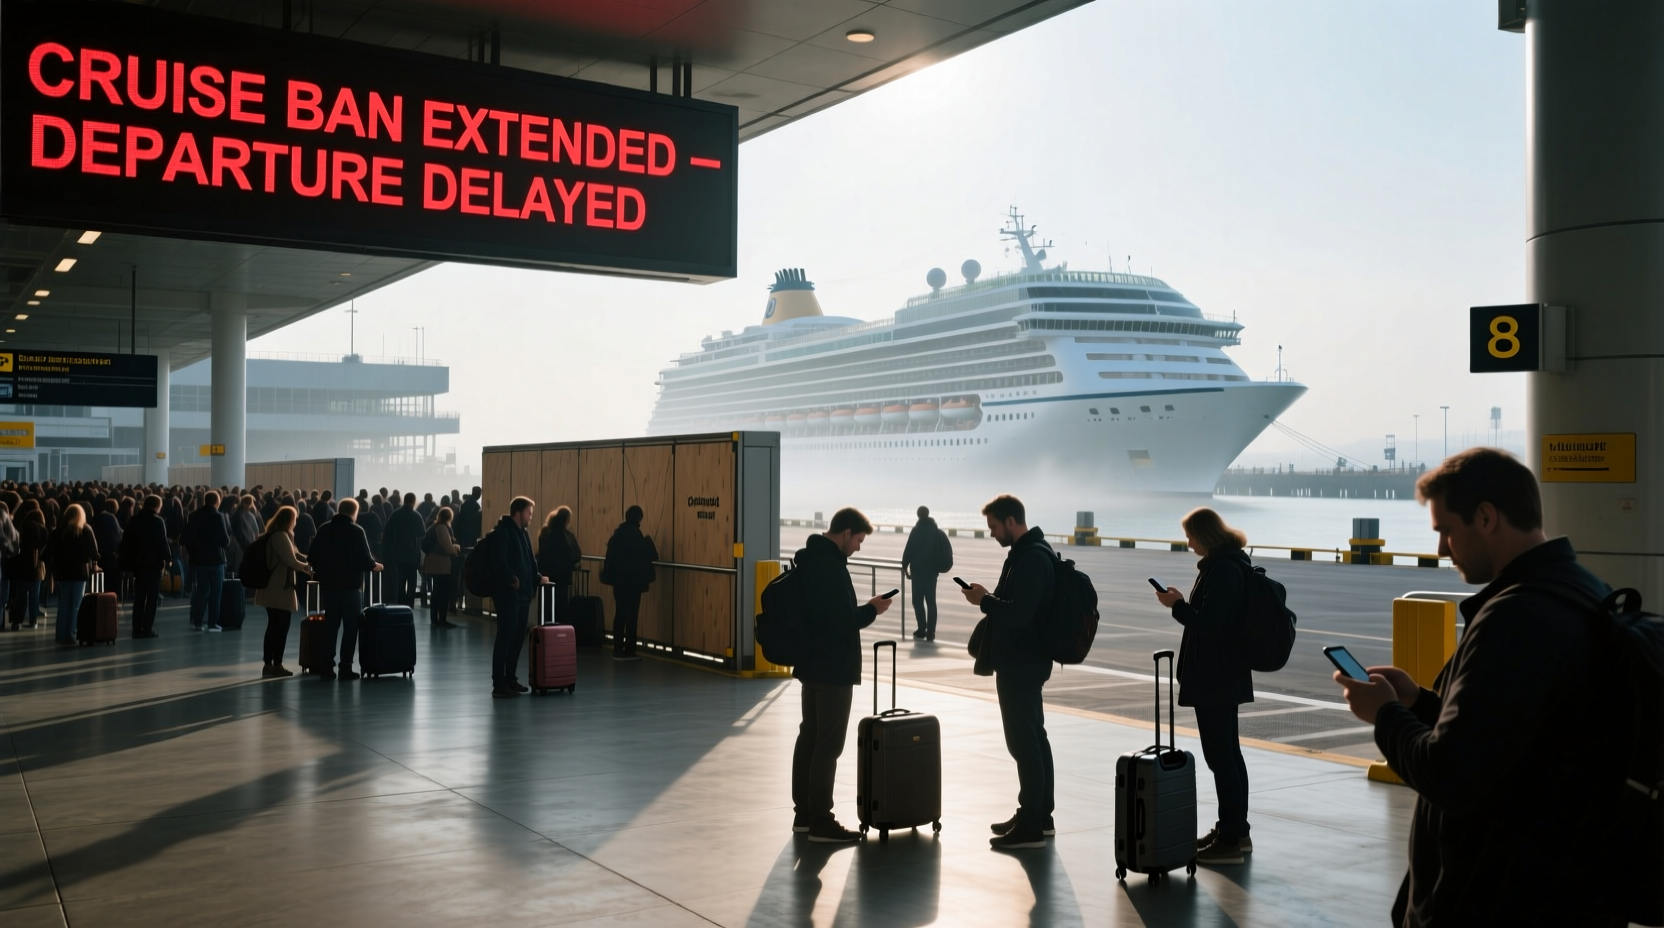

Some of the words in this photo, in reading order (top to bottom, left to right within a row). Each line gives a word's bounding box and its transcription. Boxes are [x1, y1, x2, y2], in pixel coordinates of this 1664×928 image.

[28, 42, 266, 124] CRUISE
[286, 79, 403, 143] BAN
[422, 99, 677, 177] EXTENDED
[31, 114, 404, 206] DEPARTURE
[423, 162, 646, 231] DELAYED
[1487, 315, 1521, 359] 8
